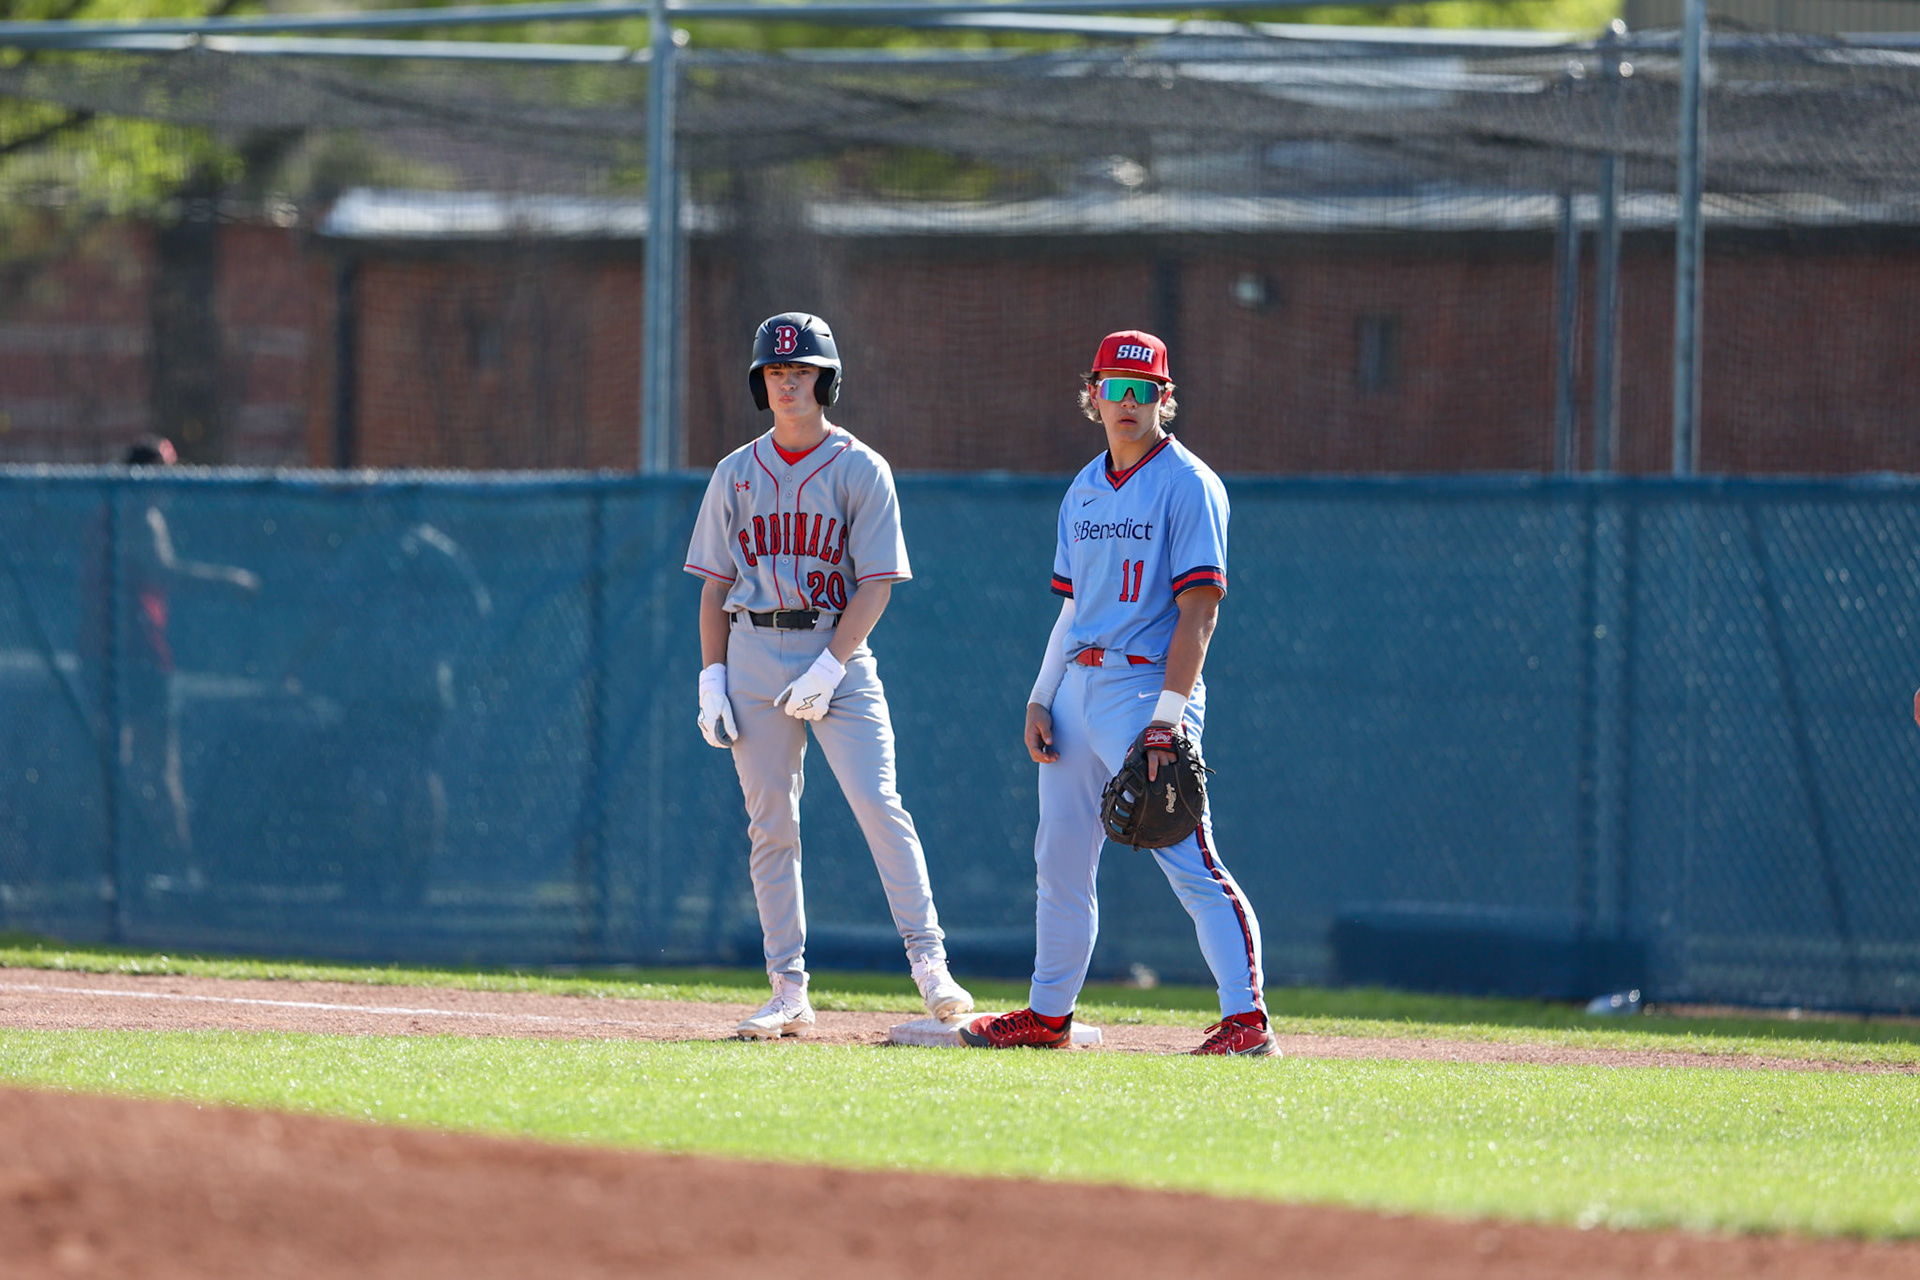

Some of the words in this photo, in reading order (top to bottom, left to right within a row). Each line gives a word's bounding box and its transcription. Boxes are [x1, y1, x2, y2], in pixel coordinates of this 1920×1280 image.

[774, 325, 798, 355] B
[1116, 344, 1155, 364] SBA
[738, 512, 848, 567] CRDINALS
[1080, 517, 1153, 541] Benedict
[807, 570, 848, 610] 20
[1119, 559, 1144, 602] 11
